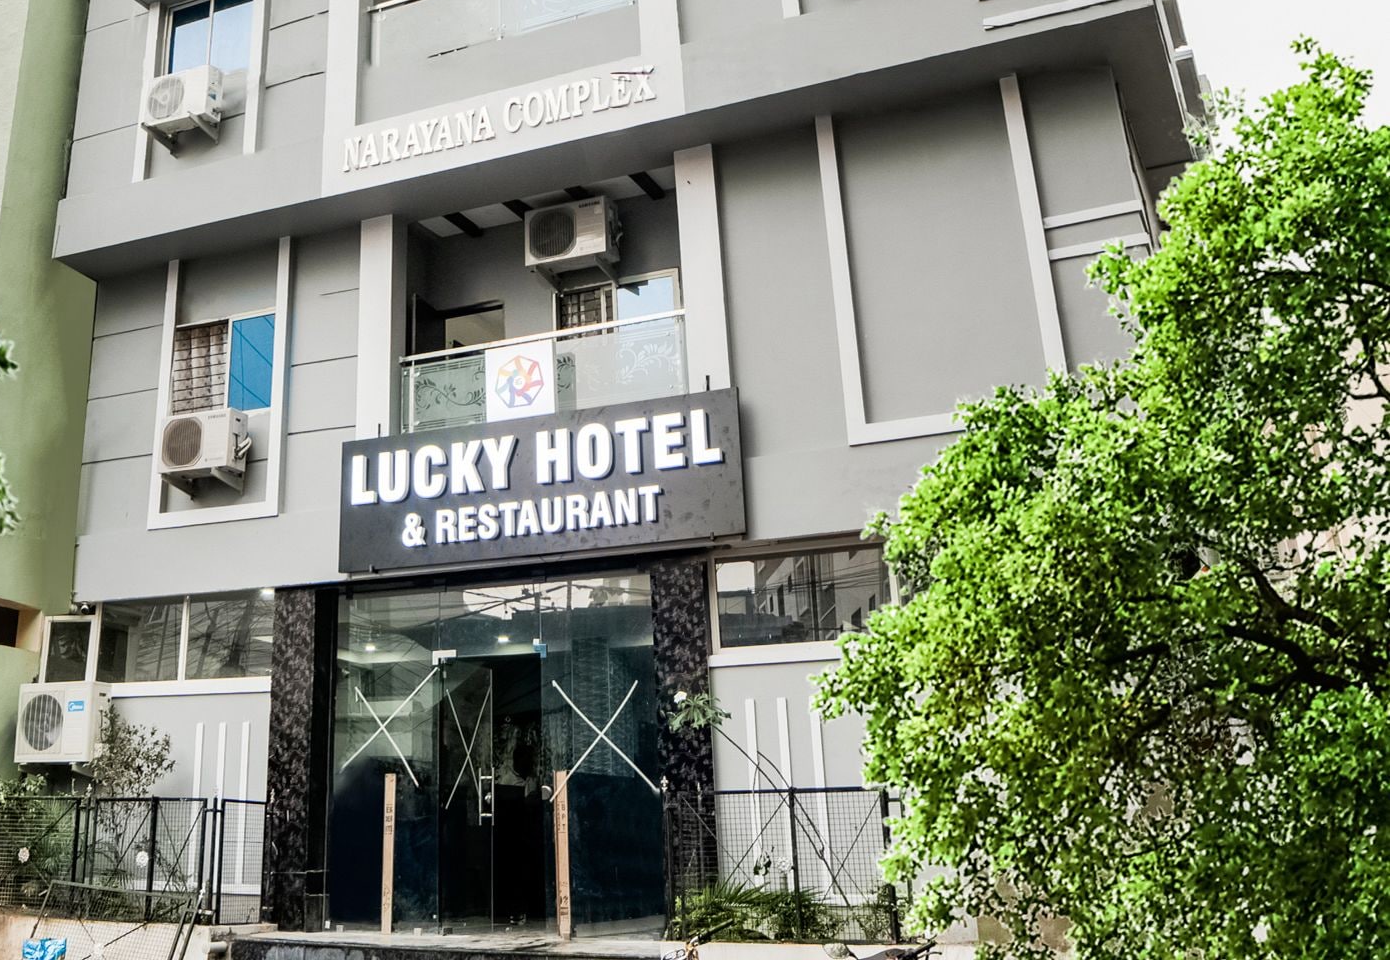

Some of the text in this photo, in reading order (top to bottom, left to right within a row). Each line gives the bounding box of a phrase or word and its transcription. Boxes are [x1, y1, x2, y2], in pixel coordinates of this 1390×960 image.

[342, 65, 657, 172] NARAYANA COMPLEX
[351, 408, 723, 505] LUCKY HOTEL
[402, 485, 662, 547] & RESTAURANT
